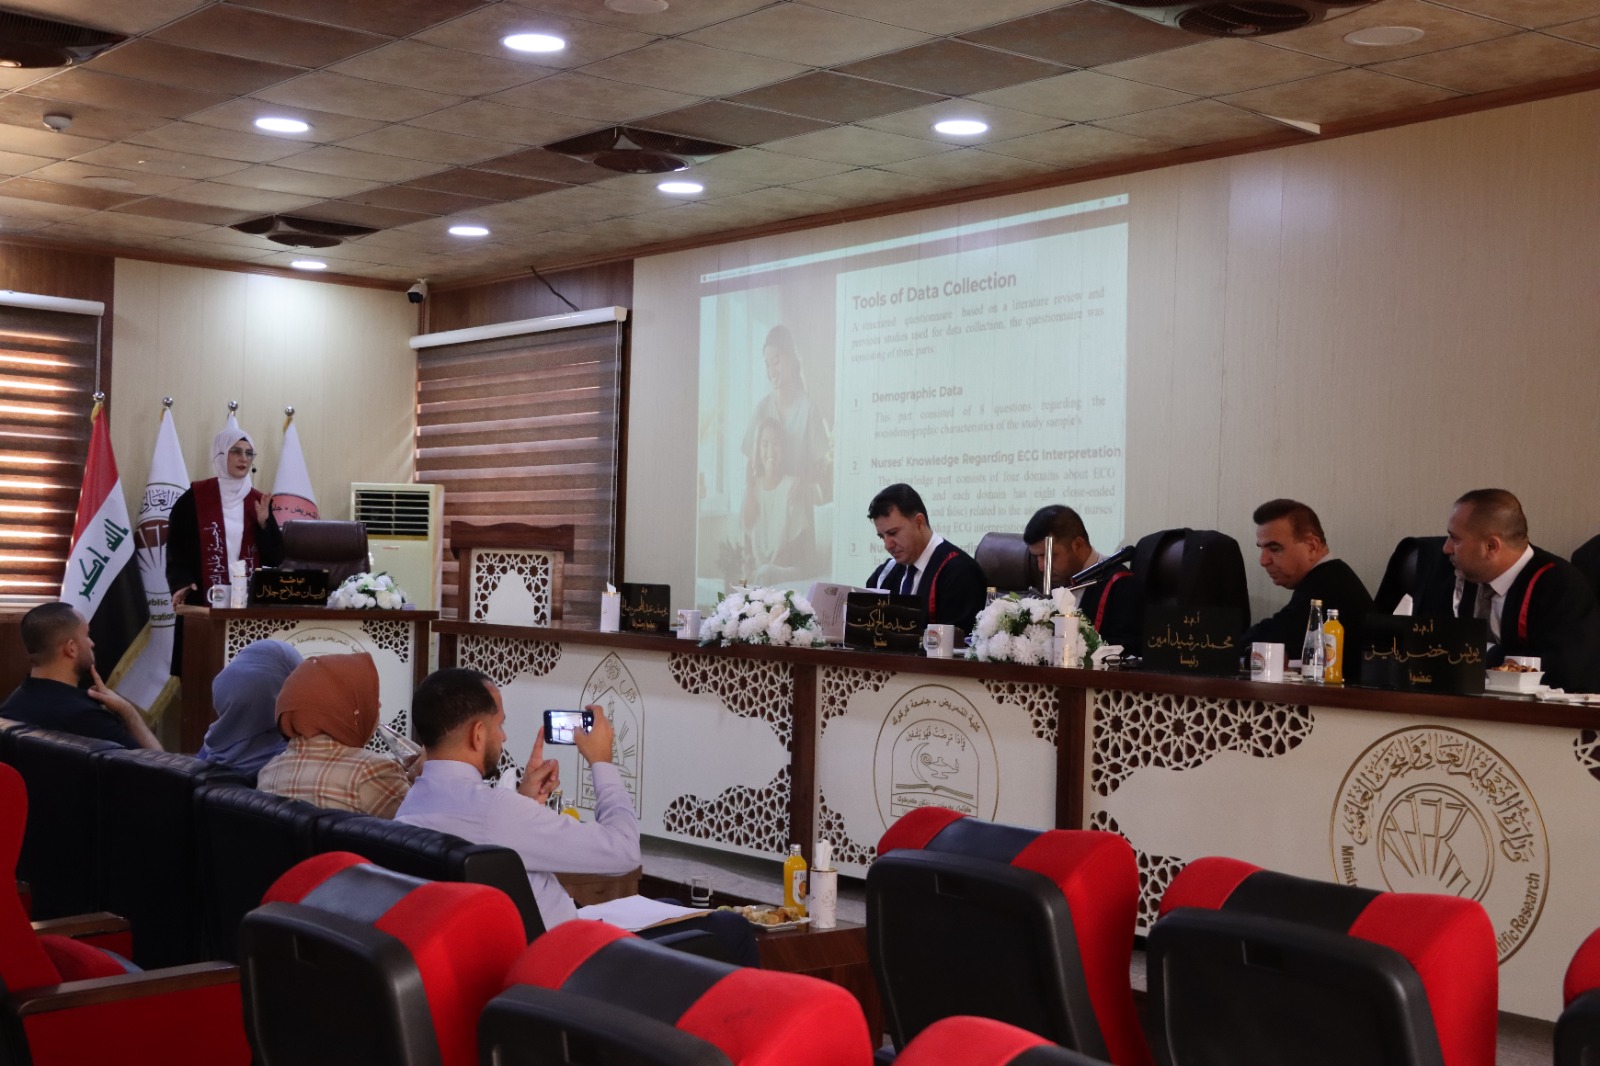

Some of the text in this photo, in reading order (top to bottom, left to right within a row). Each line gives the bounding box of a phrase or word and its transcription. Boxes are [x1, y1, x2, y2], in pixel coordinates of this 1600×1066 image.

[852, 272, 1016, 310] Tools of Data Collection
[962, 304, 984, 318] based
[988, 304, 998, 314] on
[1012, 297, 1049, 311] literature
[1054, 292, 1084, 305] review
[1088, 286, 1104, 300] and
[884, 332, 908, 344] studies
[912, 328, 928, 340] used
[932, 326, 943, 338] for
[946, 324, 962, 336] data
[1010, 316, 1022, 328] the
[1026, 310, 1082, 328] questionnaire
[1088, 307, 1104, 318] was
[887, 348, 896, 358] of
[896, 347, 914, 358] three
[872, 386, 963, 404] Demographic Data
[876, 412, 890, 422] This
[898, 411, 912, 424] part
[920, 407, 954, 420] consisted
[962, 404, 972, 416] of
[994, 402, 1032, 416] questions
[1041, 397, 1082, 412] regarding
[1092, 395, 1106, 407] the
[940, 422, 993, 434] characteristics
[996, 419, 1006, 430] of
[1007, 418, 1019, 430] the
[1021, 417, 1044, 430] study
[906, 454, 960, 468] Knowledge
[962, 451, 1014, 465] Regarding
[1017, 450, 1039, 462] ECG
[1042, 445, 1121, 462] Interpretation
[938, 474, 952, 487] part
[956, 474, 986, 484] consists
[990, 472, 998, 483] of
[1003, 471, 1020, 481] four
[1024, 470, 1059, 481] domains
[1064, 468, 1088, 480] about
[1093, 467, 1115, 480] ECG
[932, 490, 946, 500] and
[953, 490, 970, 500] each
[976, 488, 1006, 500] domain
[1013, 488, 1026, 498] has
[1034, 486, 1056, 500] eight
[1062, 484, 1115, 497] close-ended
[970, 505, 996, 516] related
[998, 506, 1006, 516] to
[1008, 504, 1020, 516] the
[104, 518, 130, 552] الله
[953, 522, 972, 533] ECG
[256, 584, 279, 598] جلال
[1170, 632, 1200, 651] رشيد
[1200, 634, 1234, 649] محمد
[1399, 644, 1448, 663] خضر
[892, 696, 981, 733] كلية التمريض جامعة كركوك
[1341, 845, 1358, 887] Minist
[1496, 872, 1540, 956] tific Research
